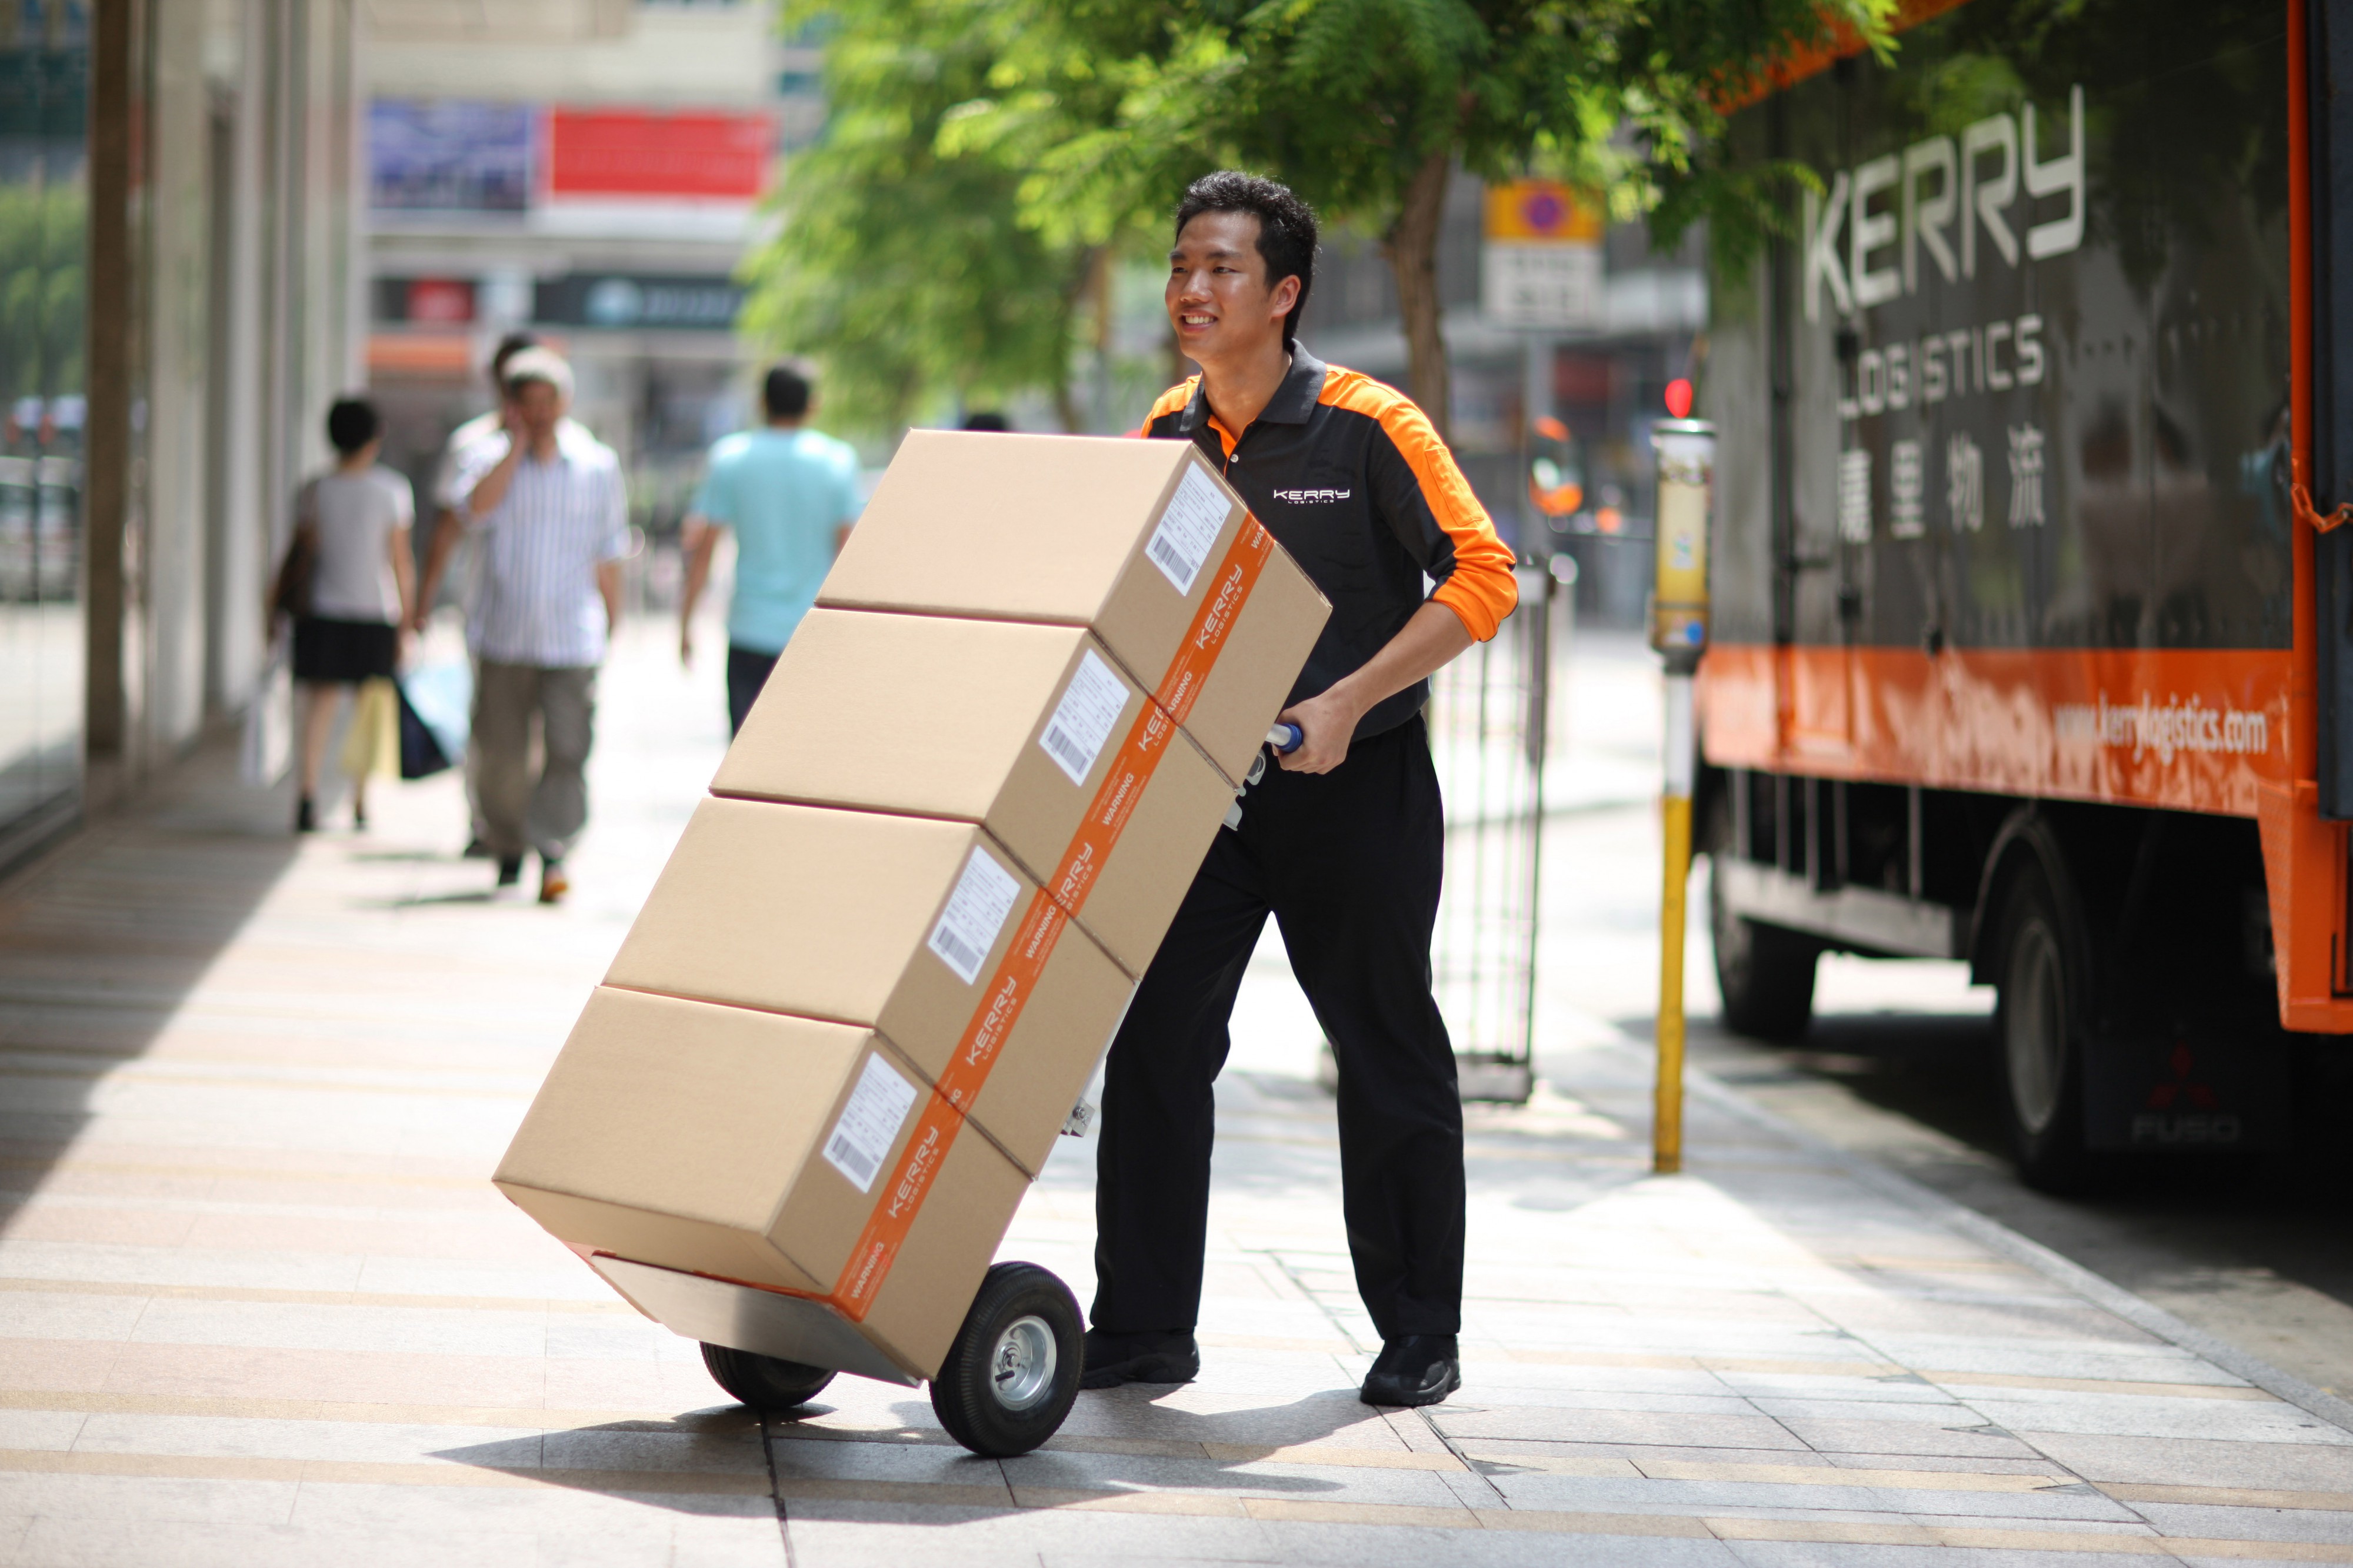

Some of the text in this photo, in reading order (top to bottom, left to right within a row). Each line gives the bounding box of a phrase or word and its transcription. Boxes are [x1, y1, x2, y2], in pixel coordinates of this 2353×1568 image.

[1804, 83, 2085, 323] KERRY
[1837, 313, 2044, 420] LOGISTICS
[1274, 489, 1350, 500] KERRY
[1196, 565, 1242, 649] KERRY
[1211, 586, 1243, 644] LOGISTICS
[1168, 672, 1192, 714] ARNING
[1103, 773, 1134, 825] WARNING
[1056, 843, 1093, 905] ERRY
[1026, 906, 1056, 958] WARNING
[966, 976, 1016, 1066] KERRY
[983, 997, 1017, 1060] LOGISTICS
[2131, 1115, 2242, 1144] FUSO
[888, 1126, 939, 1218] KERRY
[905, 1148, 939, 1212] LOGISTICS
[852, 1242, 885, 1297] WARNING
